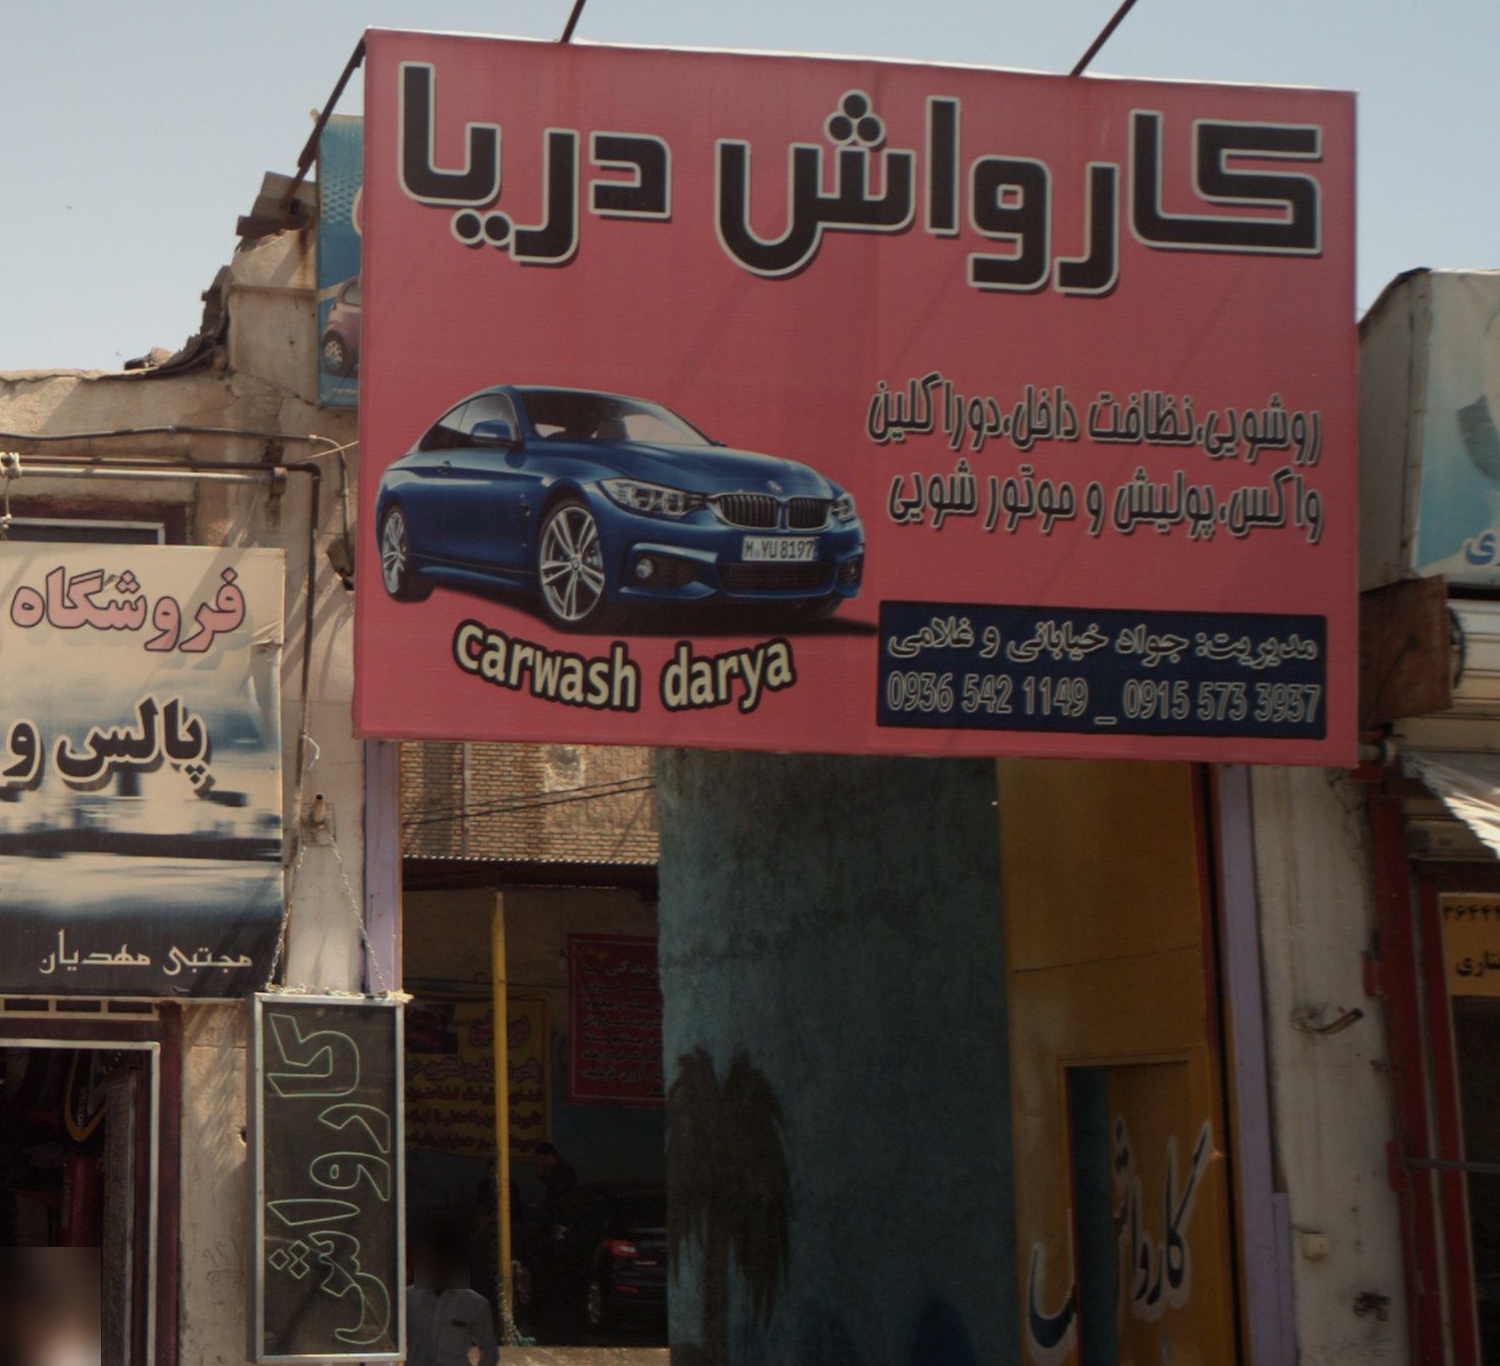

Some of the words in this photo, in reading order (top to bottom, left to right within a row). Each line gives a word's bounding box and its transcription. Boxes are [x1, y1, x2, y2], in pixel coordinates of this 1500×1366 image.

[398, 61, 672, 265] دریا
[714, 89, 1323, 296] کارواش
[1086, 478, 1105, 536] و
[10, 565, 248, 653] فروشگاه
[453, 619, 640, 712] carwash
[660, 638, 796, 715] darya
[978, 627, 1001, 657] و
[1006, 619, 1109, 663] خیابانی
[887, 671, 954, 712] 0936
[962, 674, 1013, 714] 542
[1022, 676, 1089, 717] 1149
[1122, 678, 1191, 721] 0915
[1199, 681, 1247, 721] 573
[1254, 683, 1322, 724] 3937
[2, 717, 46, 779] و
[53, 693, 212, 787] پالس
[37, 927, 152, 975] مهدیان
[162, 945, 254, 976] مجتبی
[267, 1011, 393, 1345] کارواش
